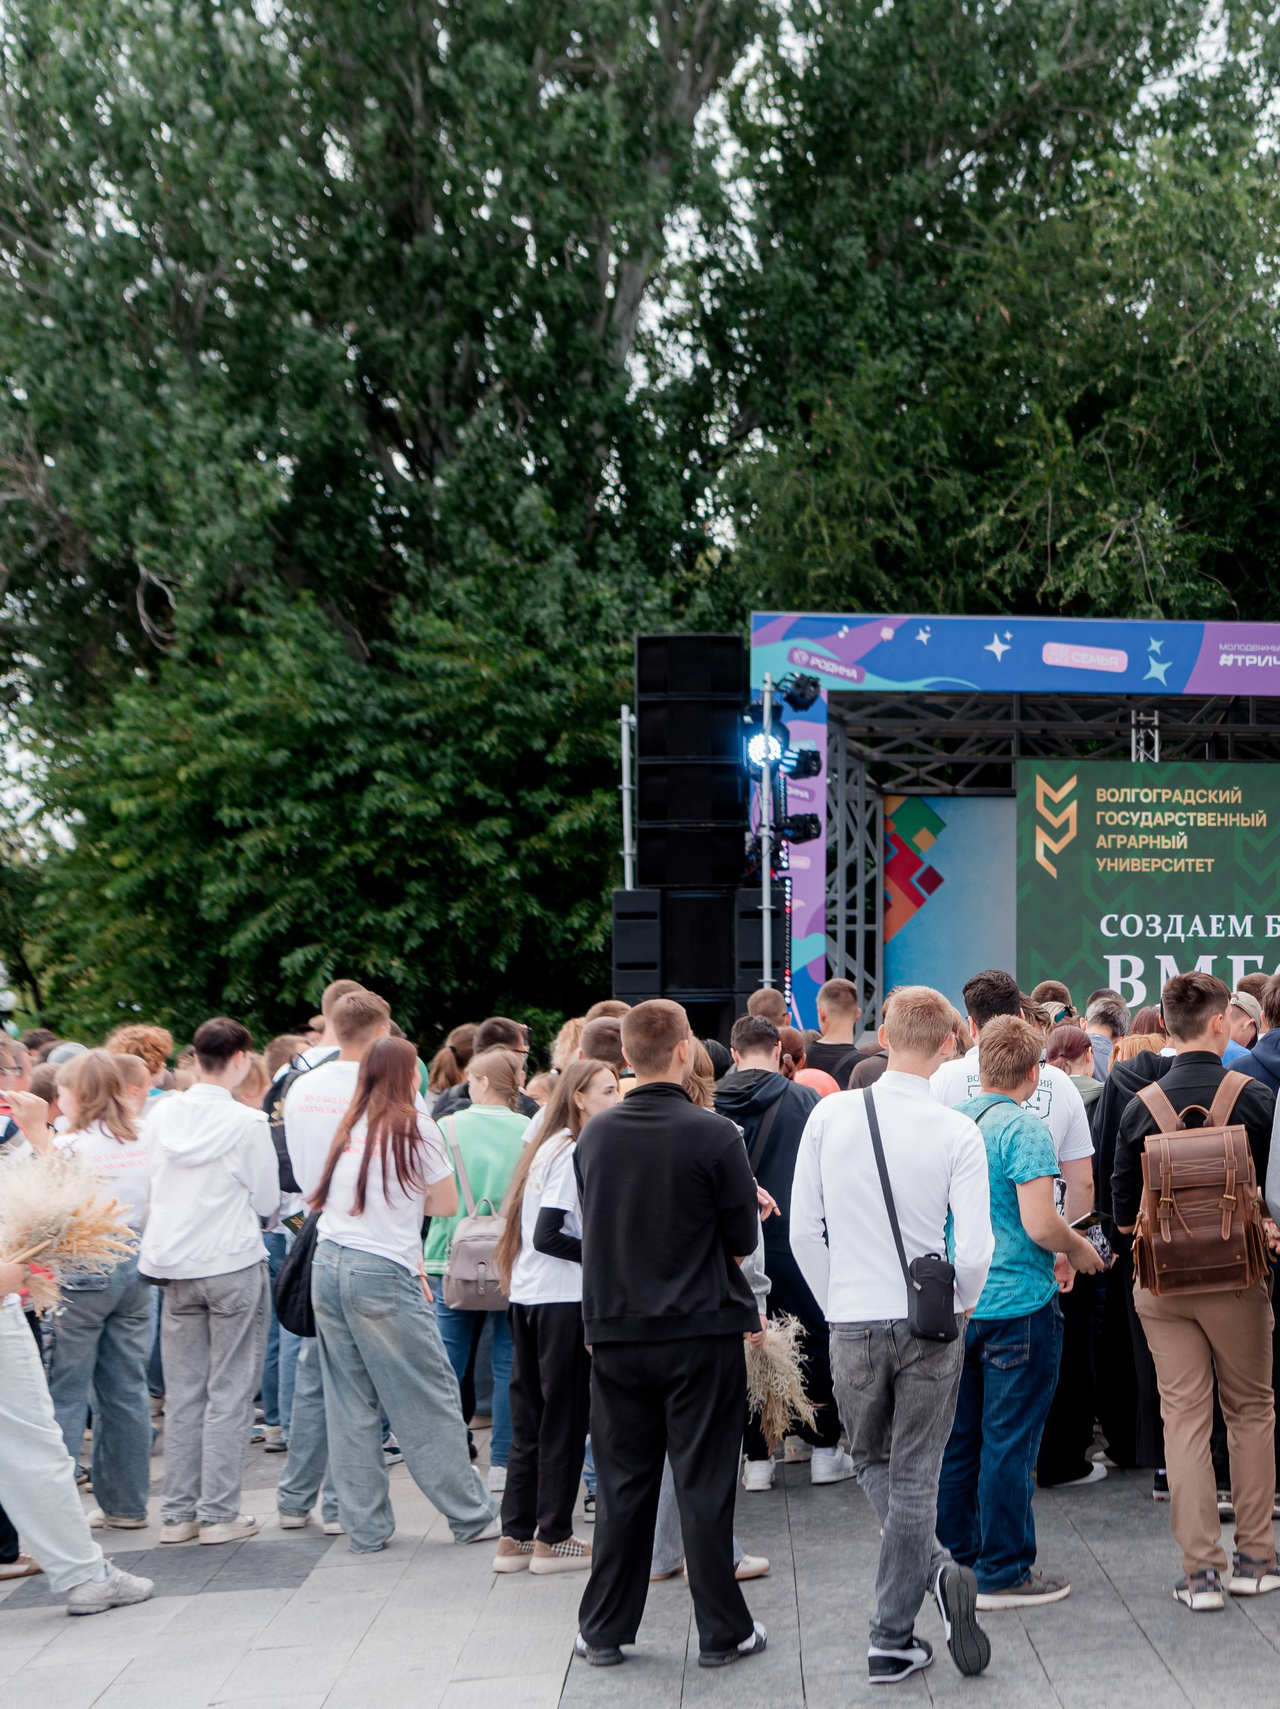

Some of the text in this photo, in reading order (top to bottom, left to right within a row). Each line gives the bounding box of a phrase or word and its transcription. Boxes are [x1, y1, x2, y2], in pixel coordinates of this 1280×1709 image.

[809, 656, 858, 680] РОДИНА
[1071, 651, 1119, 667] СЕМЬЯ
[1096, 787, 1242, 805] ВОЛГОГРАДСКИЙ
[1096, 810, 1267, 828] ГОСУДАРСТВЕННЫЙ
[1096, 832, 1188, 849] АГРАРНЫЙ
[1096, 858, 1215, 872] УНИВЕРСИТЕТ
[1100, 914, 1254, 943] СОЗДАЕМ
